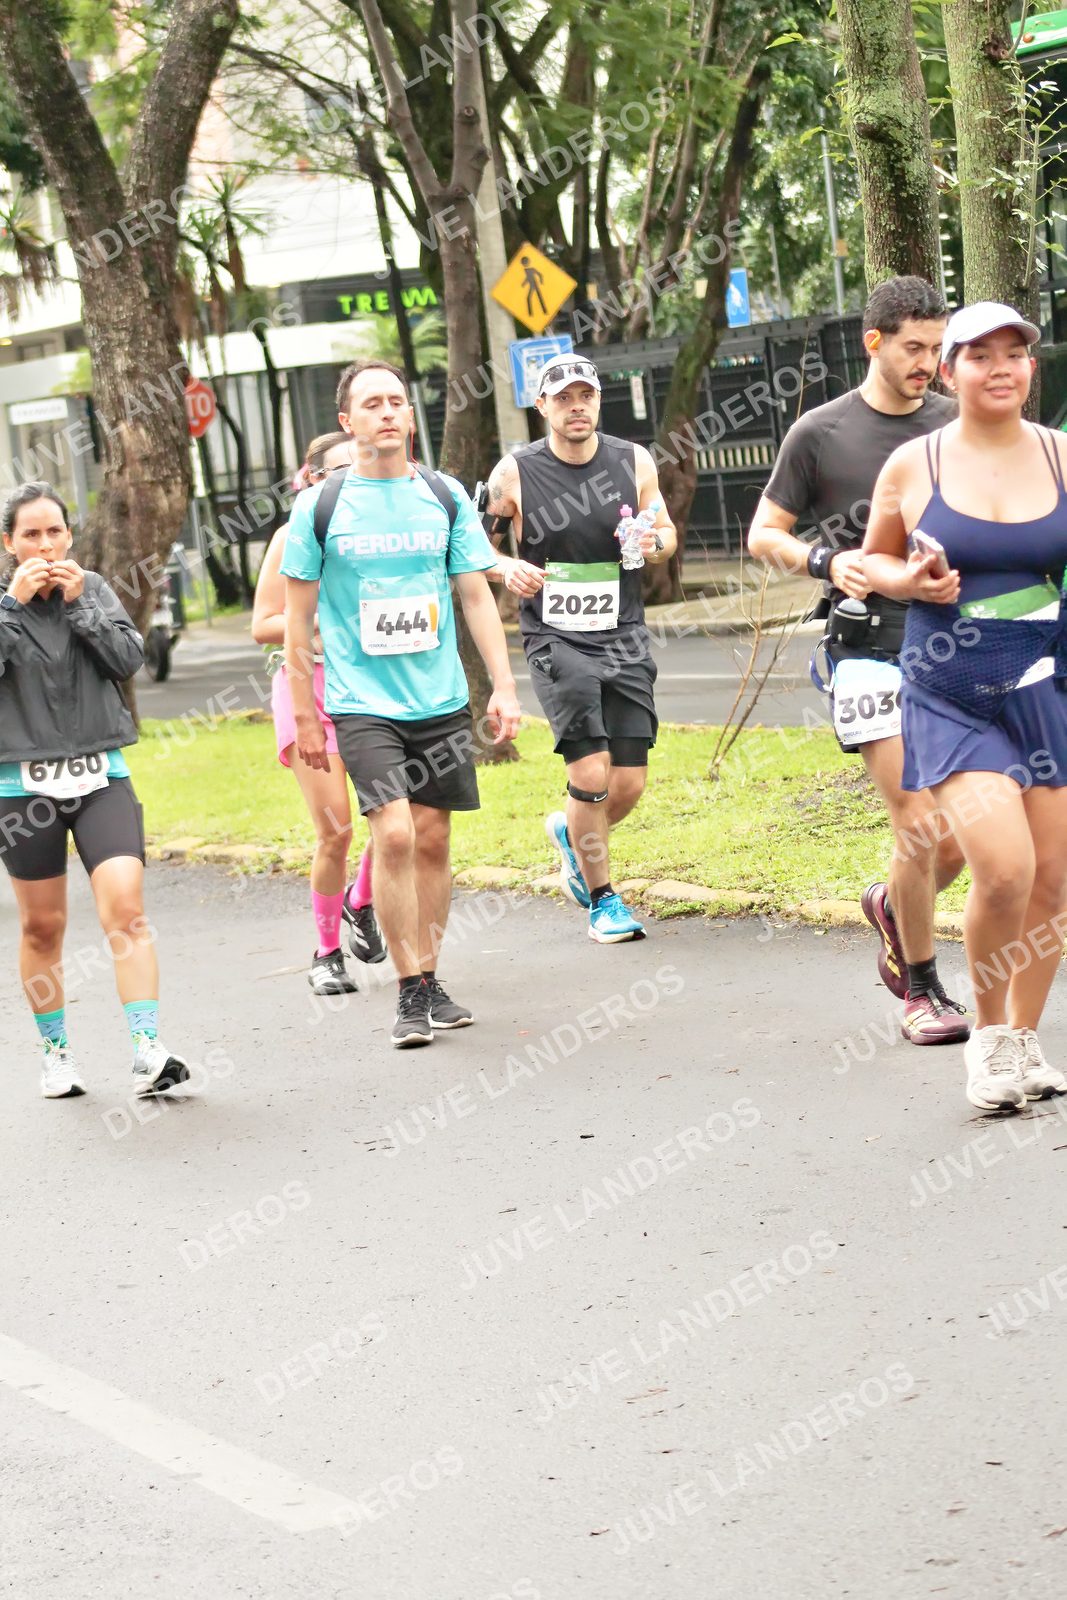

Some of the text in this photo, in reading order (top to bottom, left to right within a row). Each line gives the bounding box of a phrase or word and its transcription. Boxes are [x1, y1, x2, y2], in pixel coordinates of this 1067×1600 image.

[336, 530, 448, 556] PERDURA
[549, 594, 613, 615] 2022
[376, 610, 428, 635] 444
[29, 753, 102, 782] 6760
